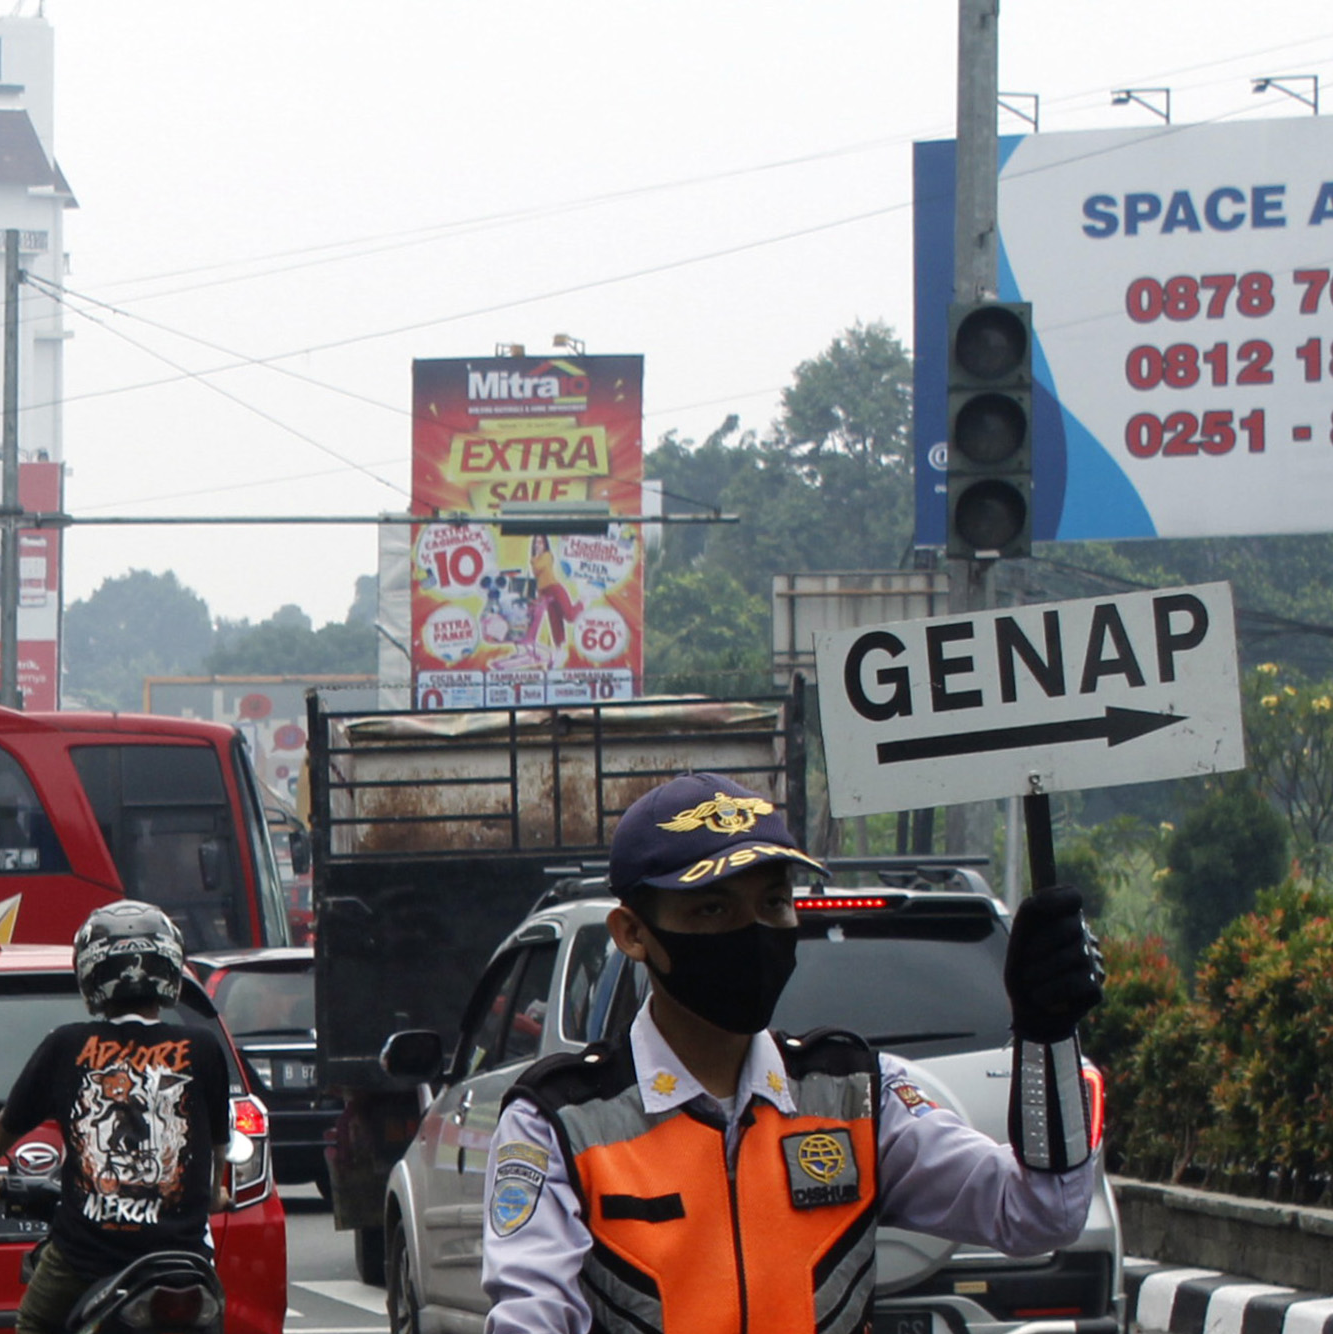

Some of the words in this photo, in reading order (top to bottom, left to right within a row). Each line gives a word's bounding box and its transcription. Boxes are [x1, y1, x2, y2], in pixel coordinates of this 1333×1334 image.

[1081, 183, 1288, 239] SPACE
[1307, 181, 1333, 226] A
[1125, 271, 1275, 323] 0878
[1293, 268, 1333, 315] 7
[468, 371, 590, 400] Mitra10
[1125, 339, 1275, 391] 0812
[1296, 337, 1333, 384] 1
[460, 435, 598, 472] EXTRA
[1124, 408, 1266, 459] 0251
[843, 592, 1209, 722] GENAP
[19, 1221, 48, 1231] 12-2
[83, 1195, 163, 1224] MERCH
